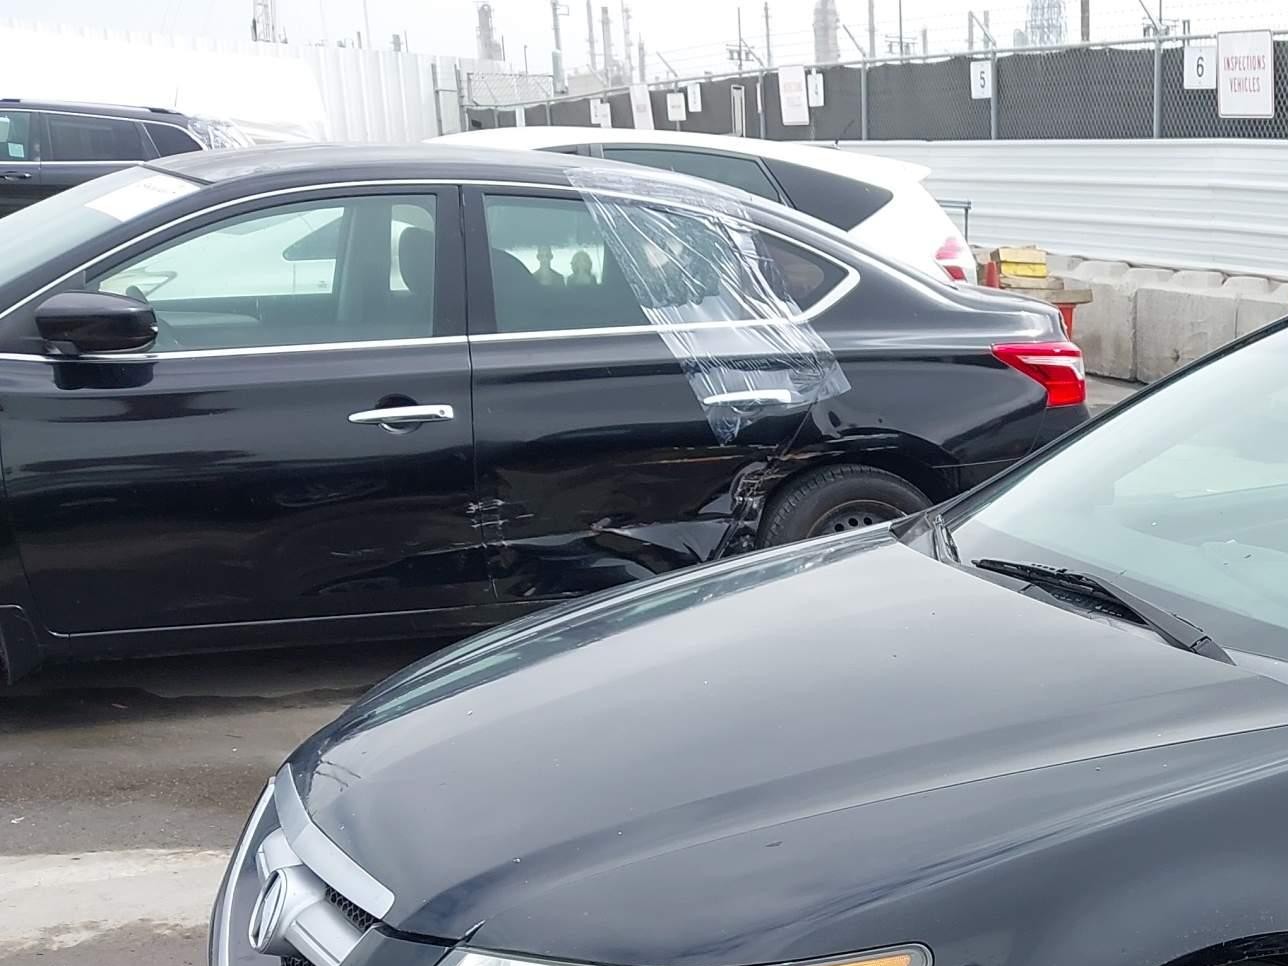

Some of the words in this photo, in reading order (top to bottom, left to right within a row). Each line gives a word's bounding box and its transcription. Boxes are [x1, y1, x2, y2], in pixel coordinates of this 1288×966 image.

[1196, 56, 1205, 78] 6
[1223, 55, 1265, 71] INSPECTIONS
[980, 70, 986, 89] 5
[1229, 77, 1261, 93] VEHICLES
